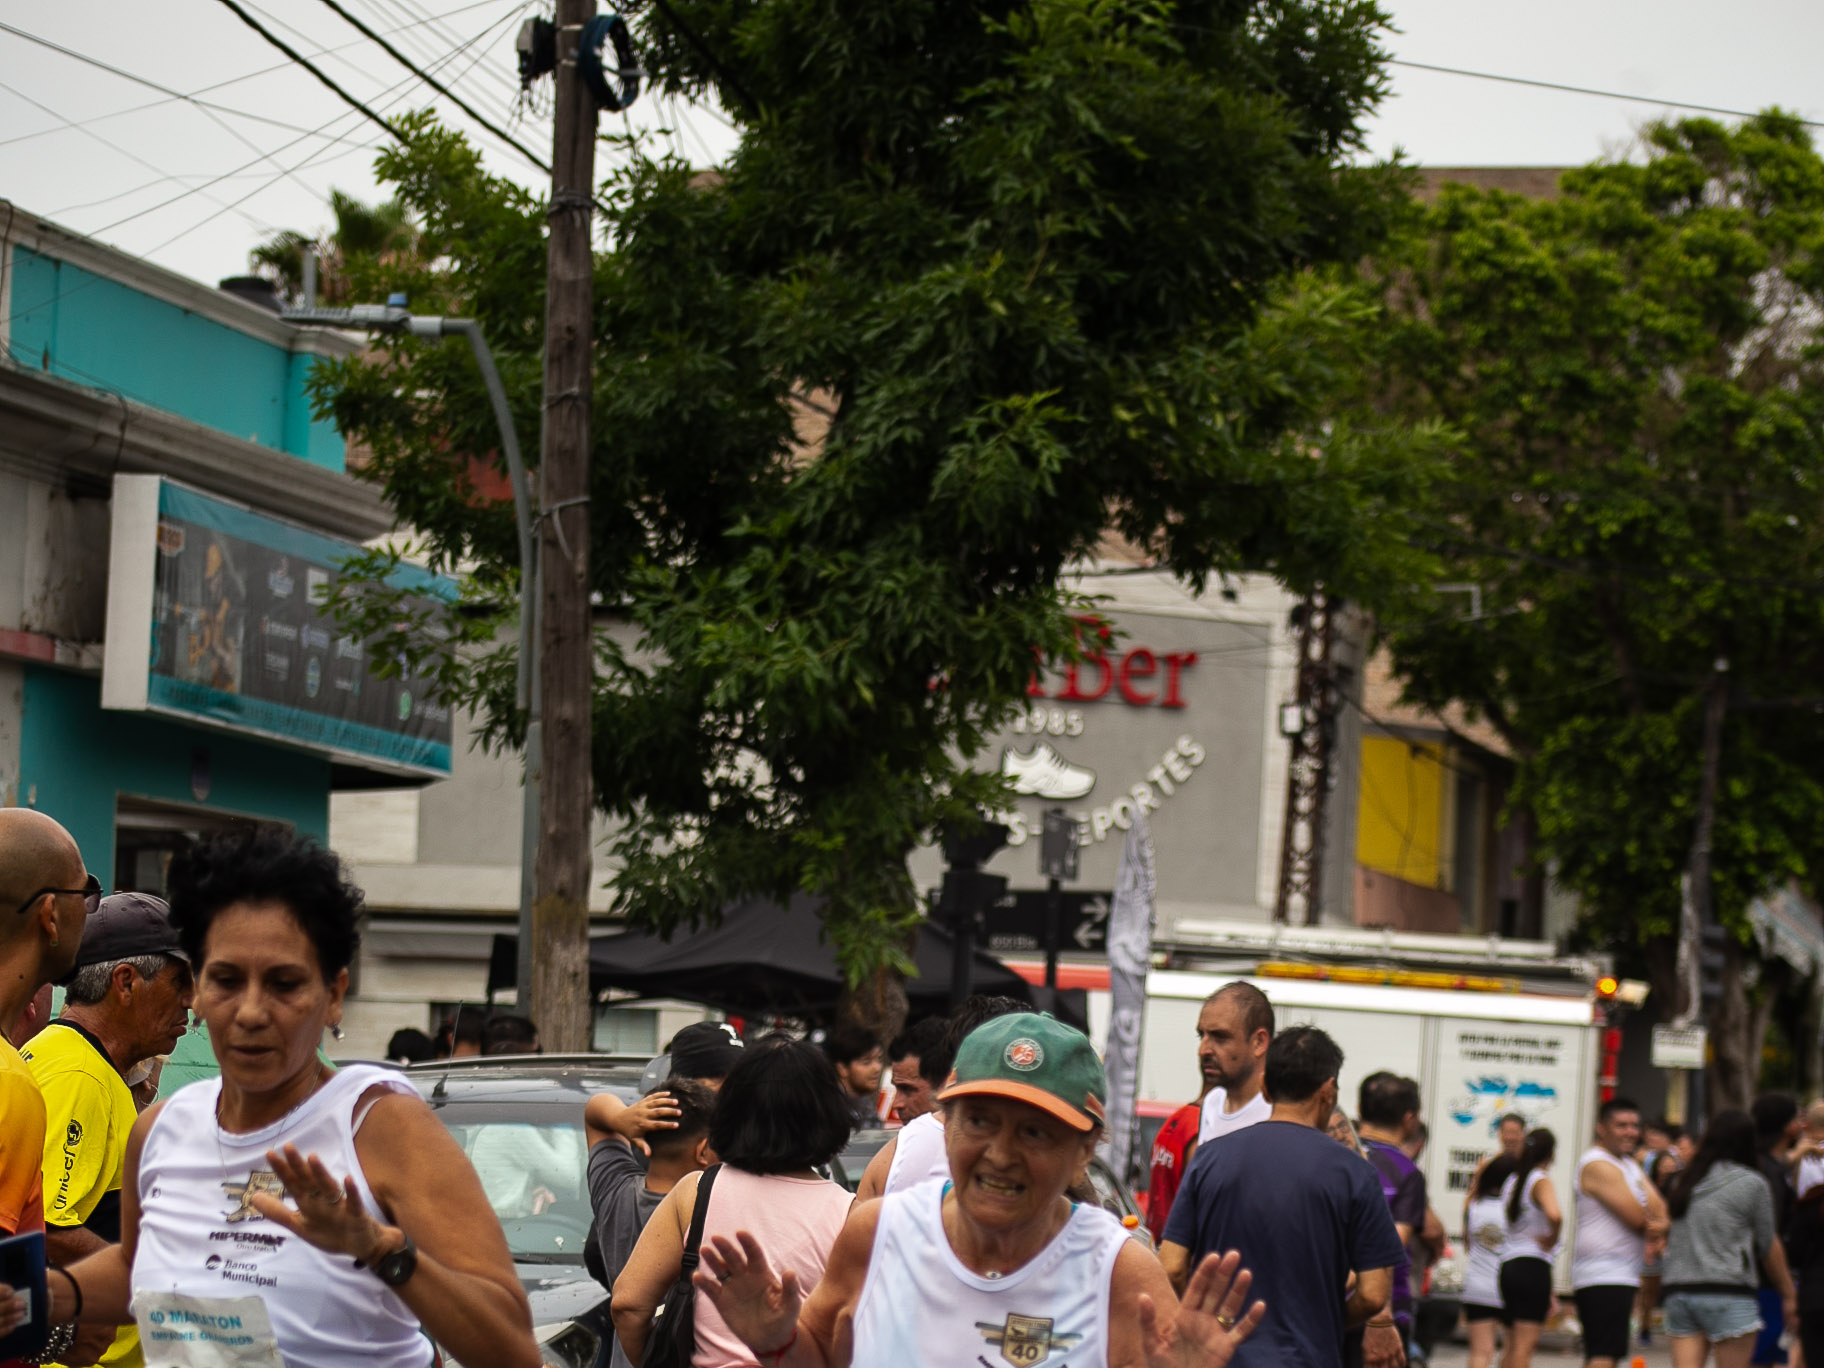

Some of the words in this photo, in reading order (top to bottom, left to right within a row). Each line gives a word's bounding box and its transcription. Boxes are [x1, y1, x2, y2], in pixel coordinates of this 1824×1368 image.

[54, 1143, 76, 1210] unicef
[224, 1259, 258, 1271] Banco
[222, 1270, 278, 1288] Municipal
[1012, 1345, 1038, 1361] 40
